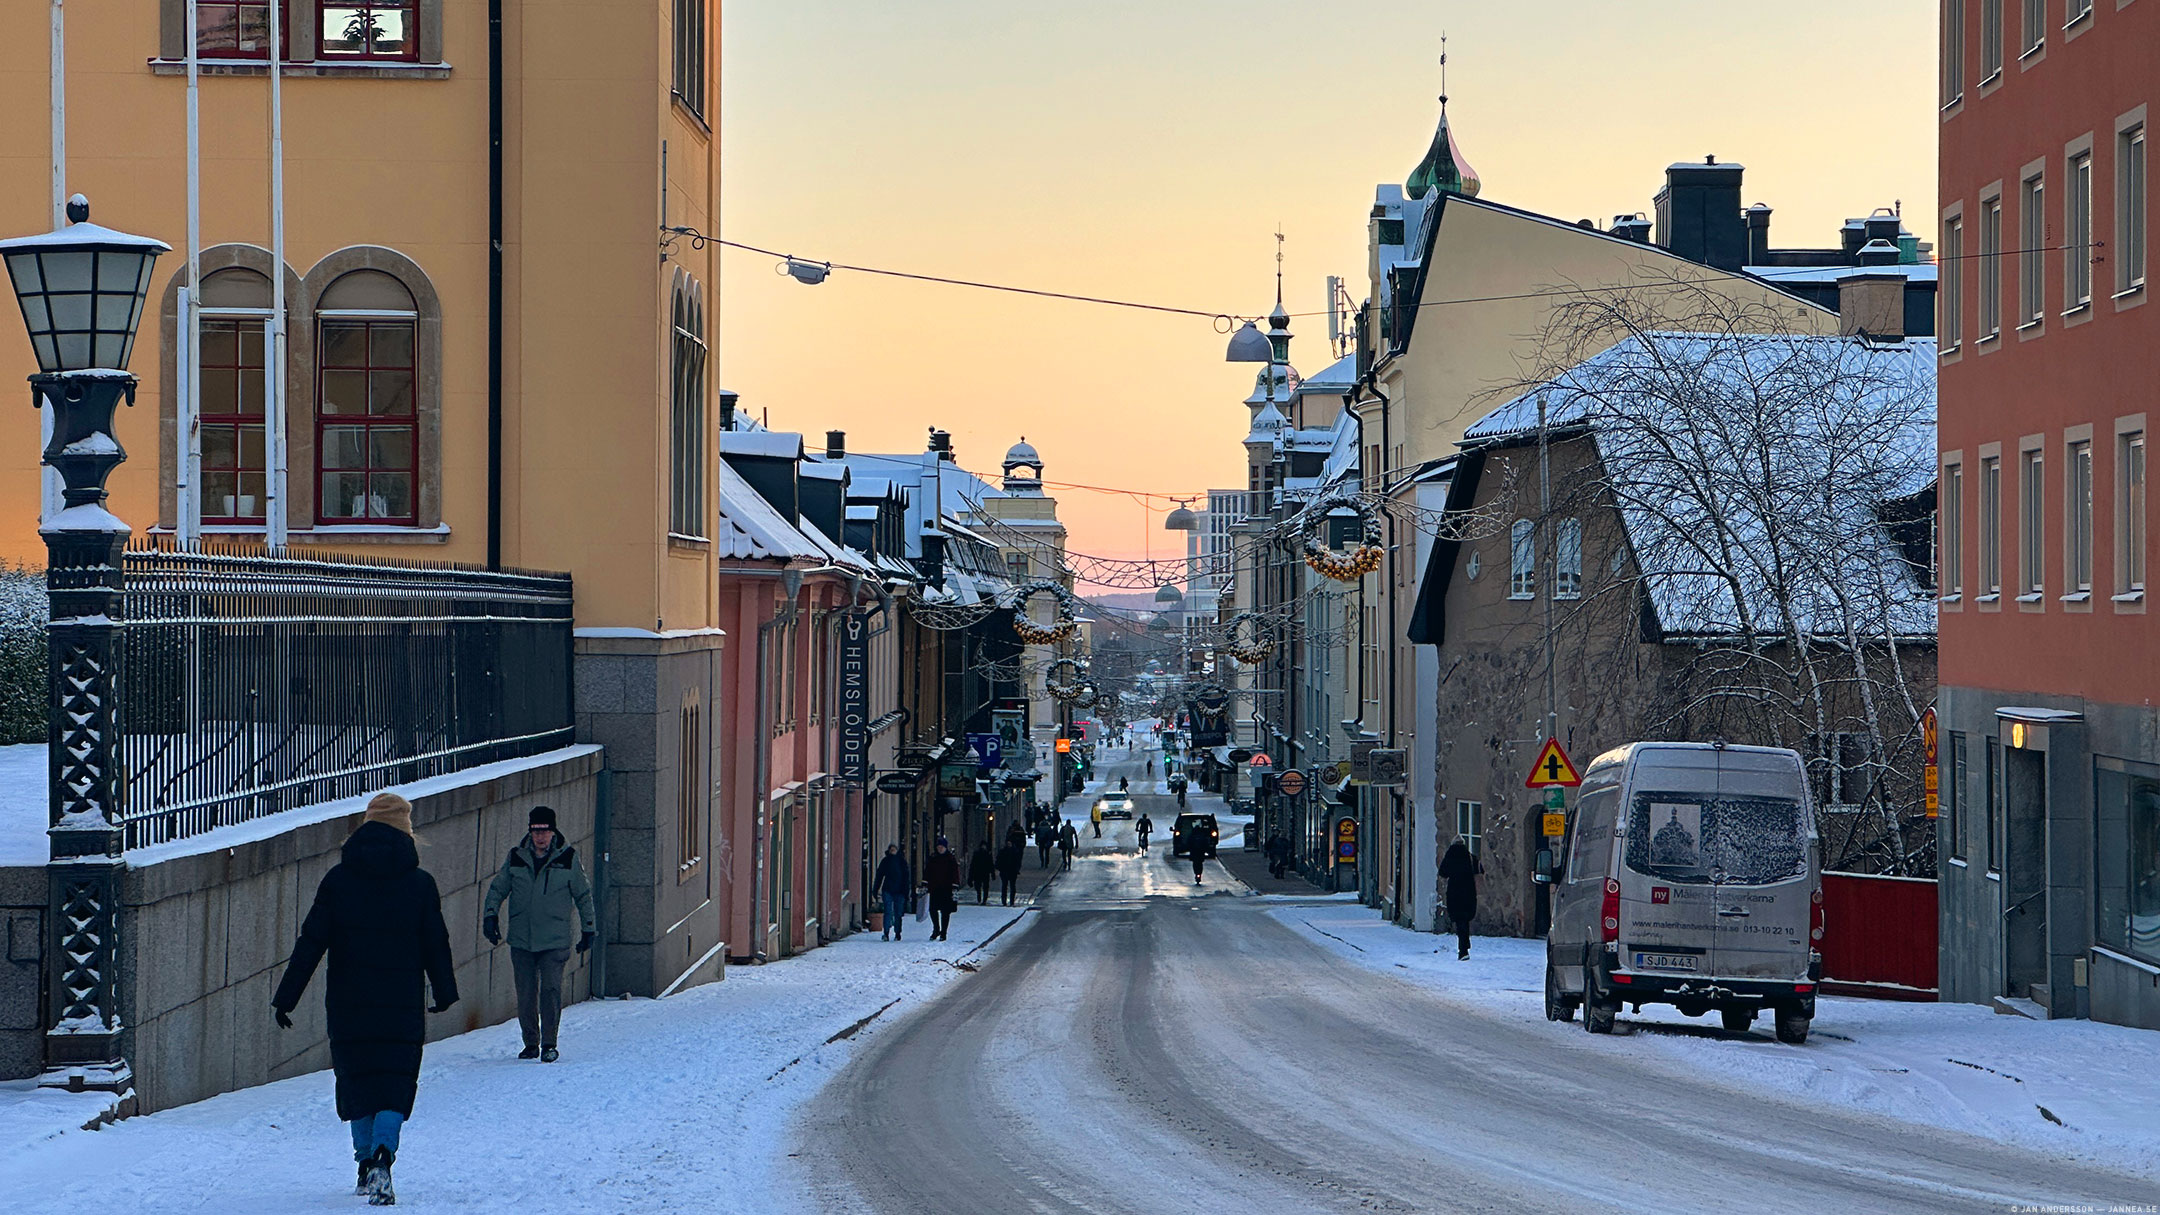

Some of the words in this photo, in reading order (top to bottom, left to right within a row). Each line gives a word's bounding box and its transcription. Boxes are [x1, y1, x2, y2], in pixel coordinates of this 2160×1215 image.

[844, 647, 862, 777] HEMSLÖJDEN
[986, 742, 998, 757] P
[1654, 890, 1667, 901] ny
[1743, 925, 1771, 935] 013-10
[1772, 926, 1783, 936] 22
[1785, 927, 1795, 936] 10
[1647, 955, 1668, 967] SJD
[1671, 956, 1693, 968] 443
